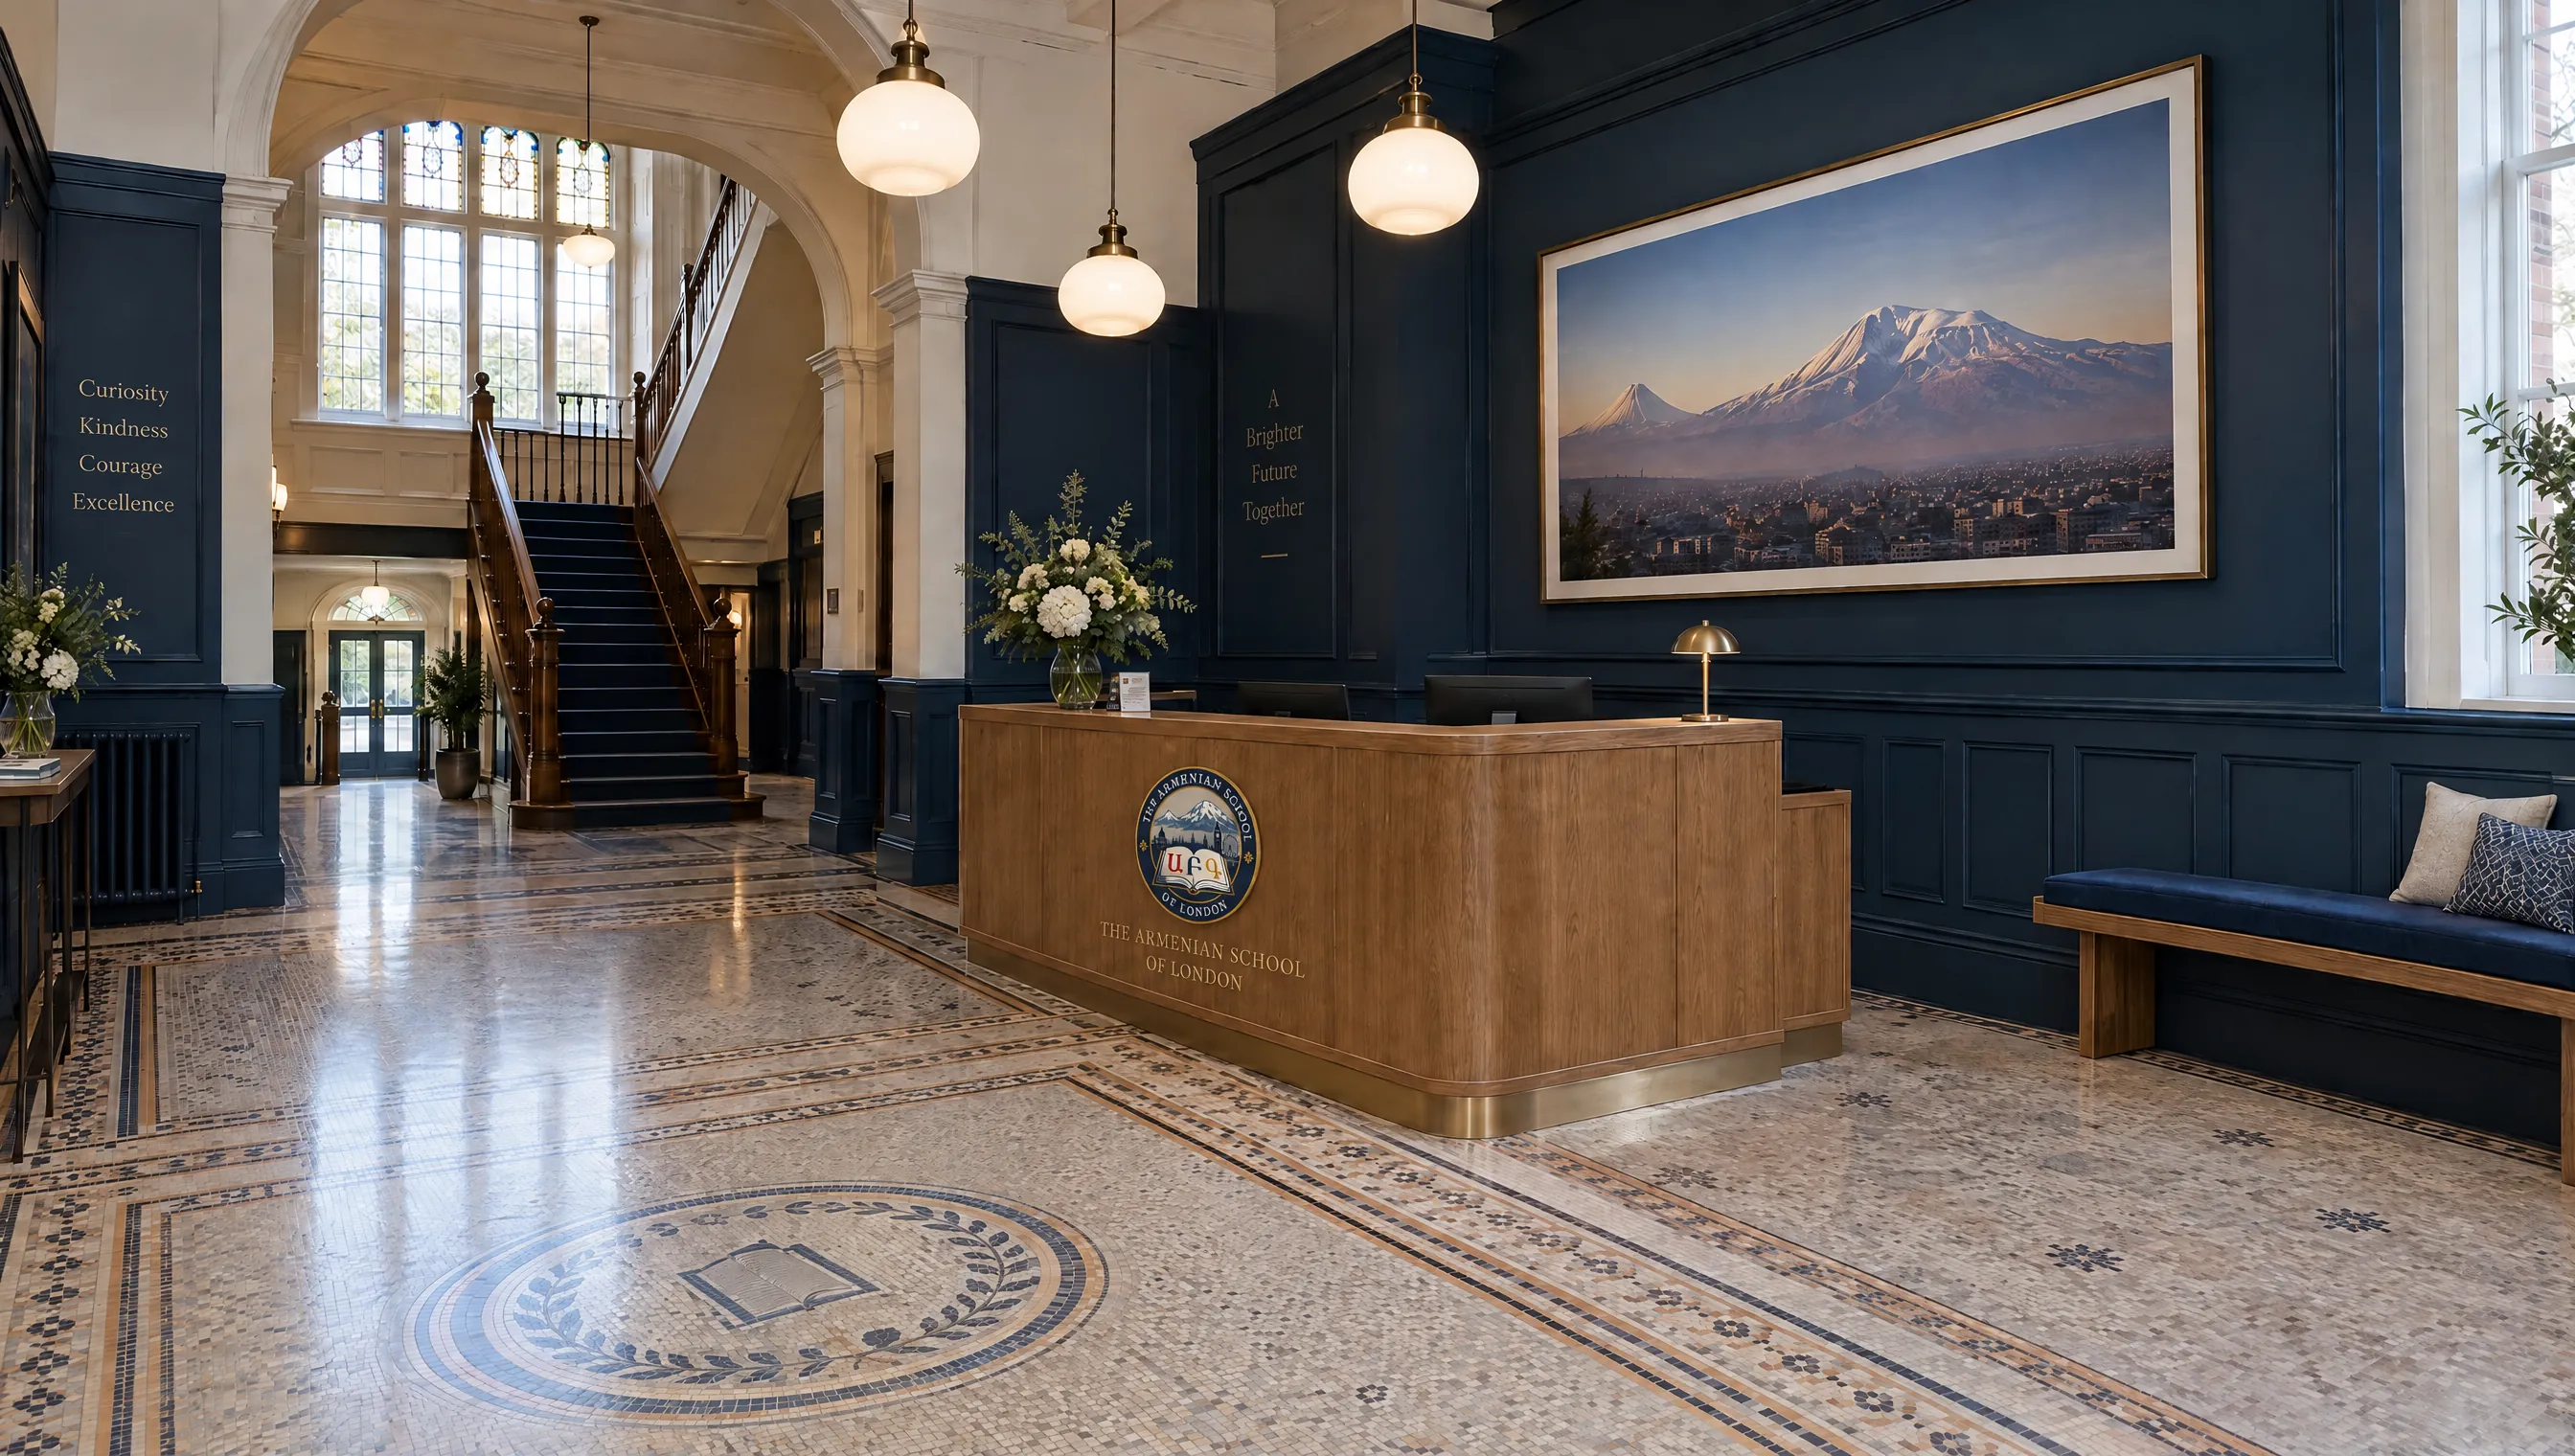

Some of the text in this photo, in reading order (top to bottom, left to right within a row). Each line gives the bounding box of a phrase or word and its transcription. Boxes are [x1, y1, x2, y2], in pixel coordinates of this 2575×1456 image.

[80, 379, 170, 407] Curiosity
[1268, 389, 1280, 409] A
[80, 417, 169, 439] Kindness
[1246, 422, 1304, 450] Brighter
[79, 454, 163, 480] Courage
[1251, 464, 1298, 484] Future
[73, 492, 174, 513] Excellence
[1242, 497, 1305, 526] Together
[1157, 773, 1222, 800] ARMENIAN
[1179, 899, 1228, 917] LONDON
[1100, 921, 1306, 978] THE ARMENIAN SCHOOL
[1146, 956, 1243, 991] OF LONDON
